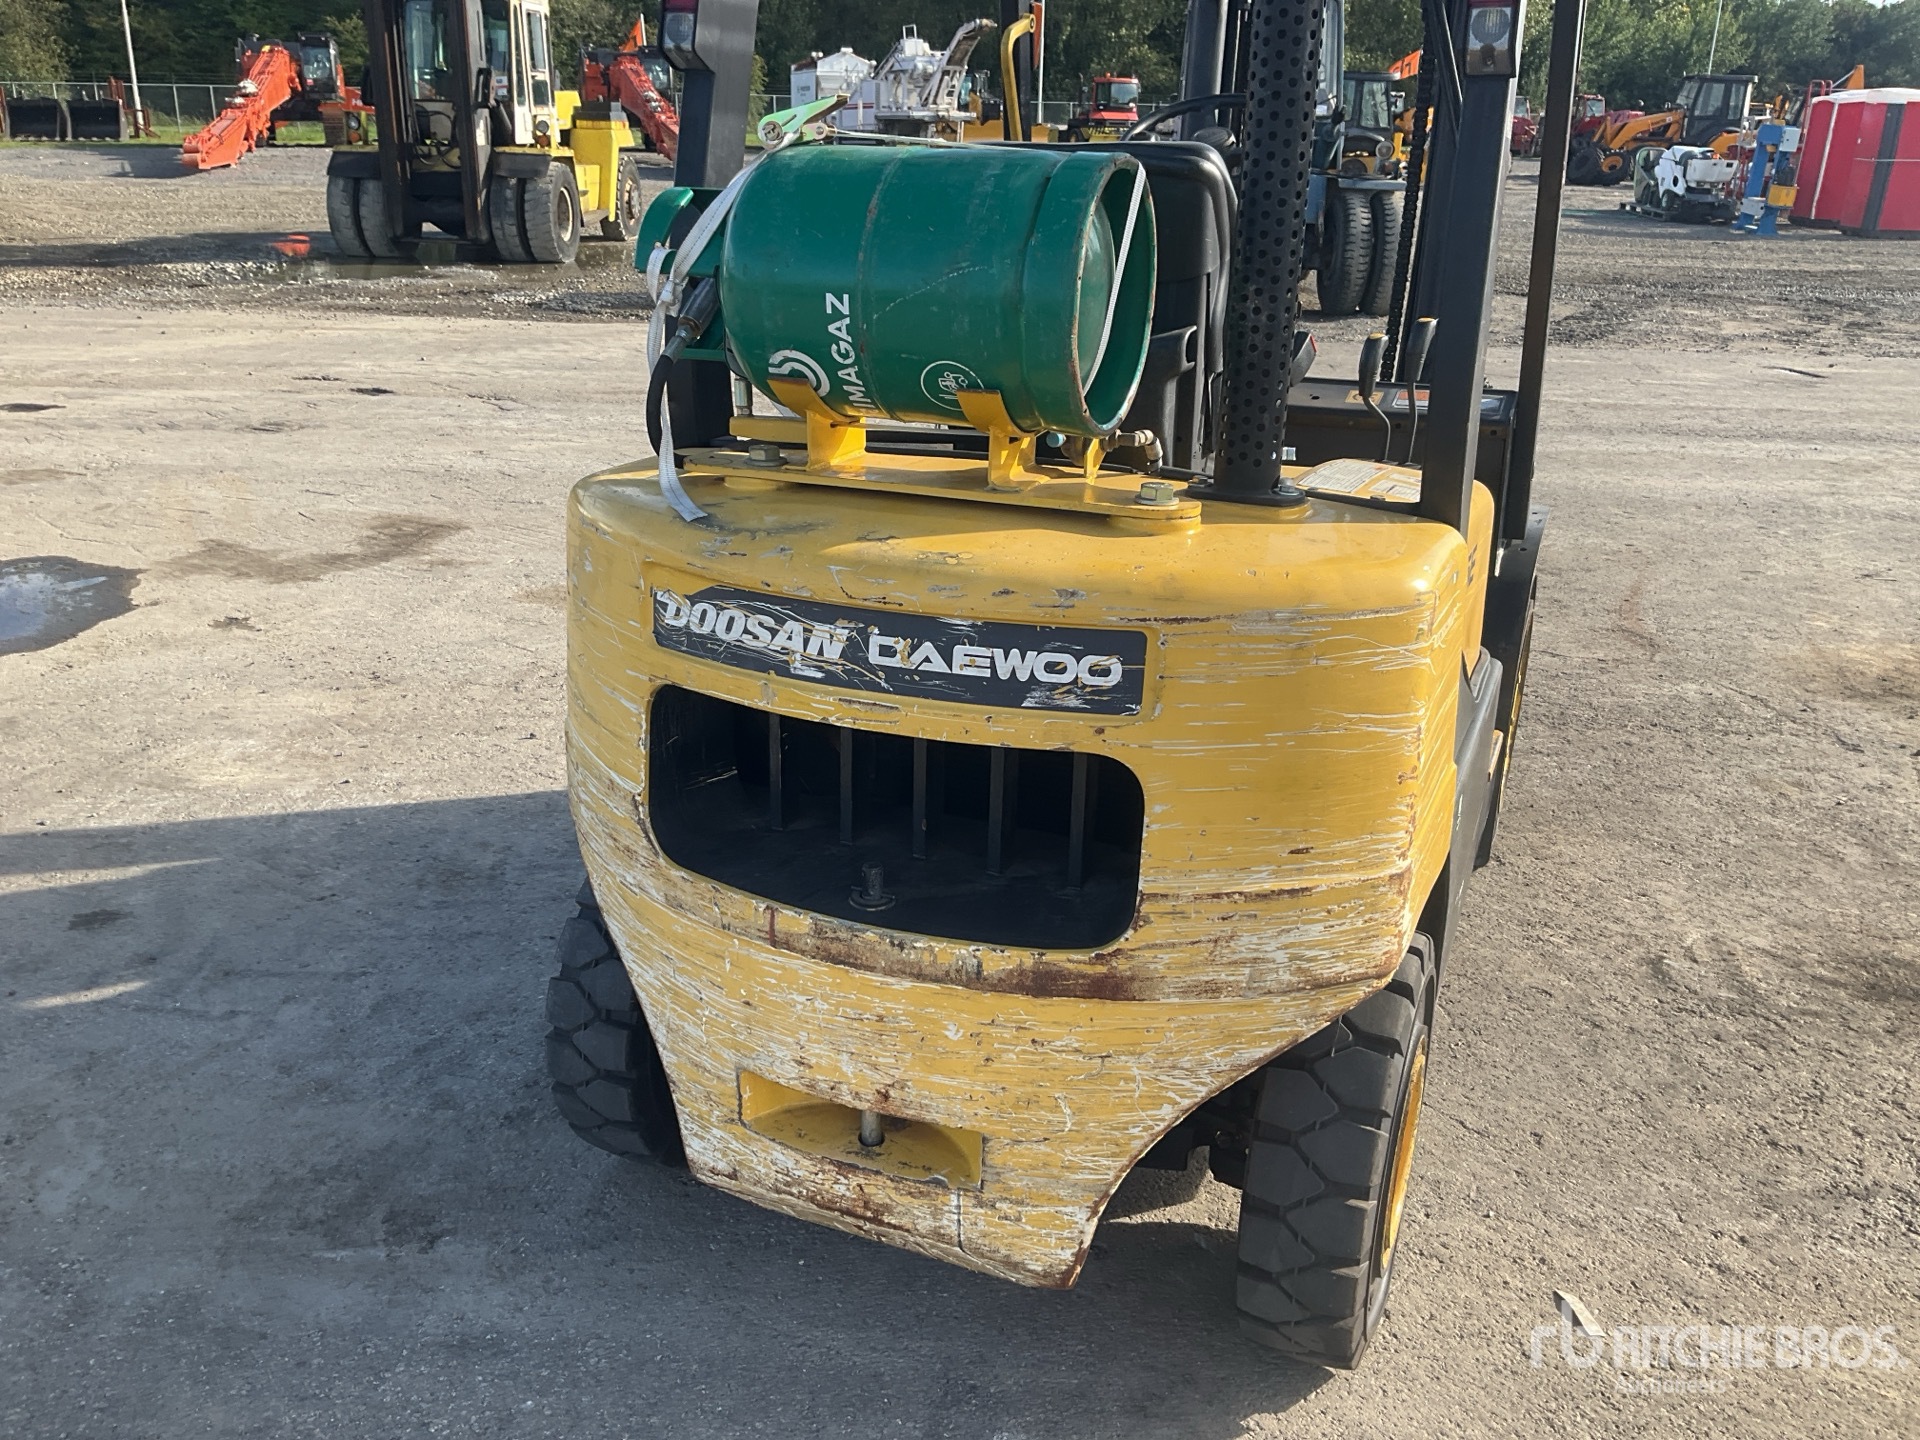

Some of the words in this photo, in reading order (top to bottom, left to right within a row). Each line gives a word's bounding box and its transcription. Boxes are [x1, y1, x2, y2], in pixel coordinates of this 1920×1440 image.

[826, 292, 878, 411] IMAGAZ
[656, 590, 849, 660] DOOSAN
[868, 635, 1122, 686] DAEWOO
